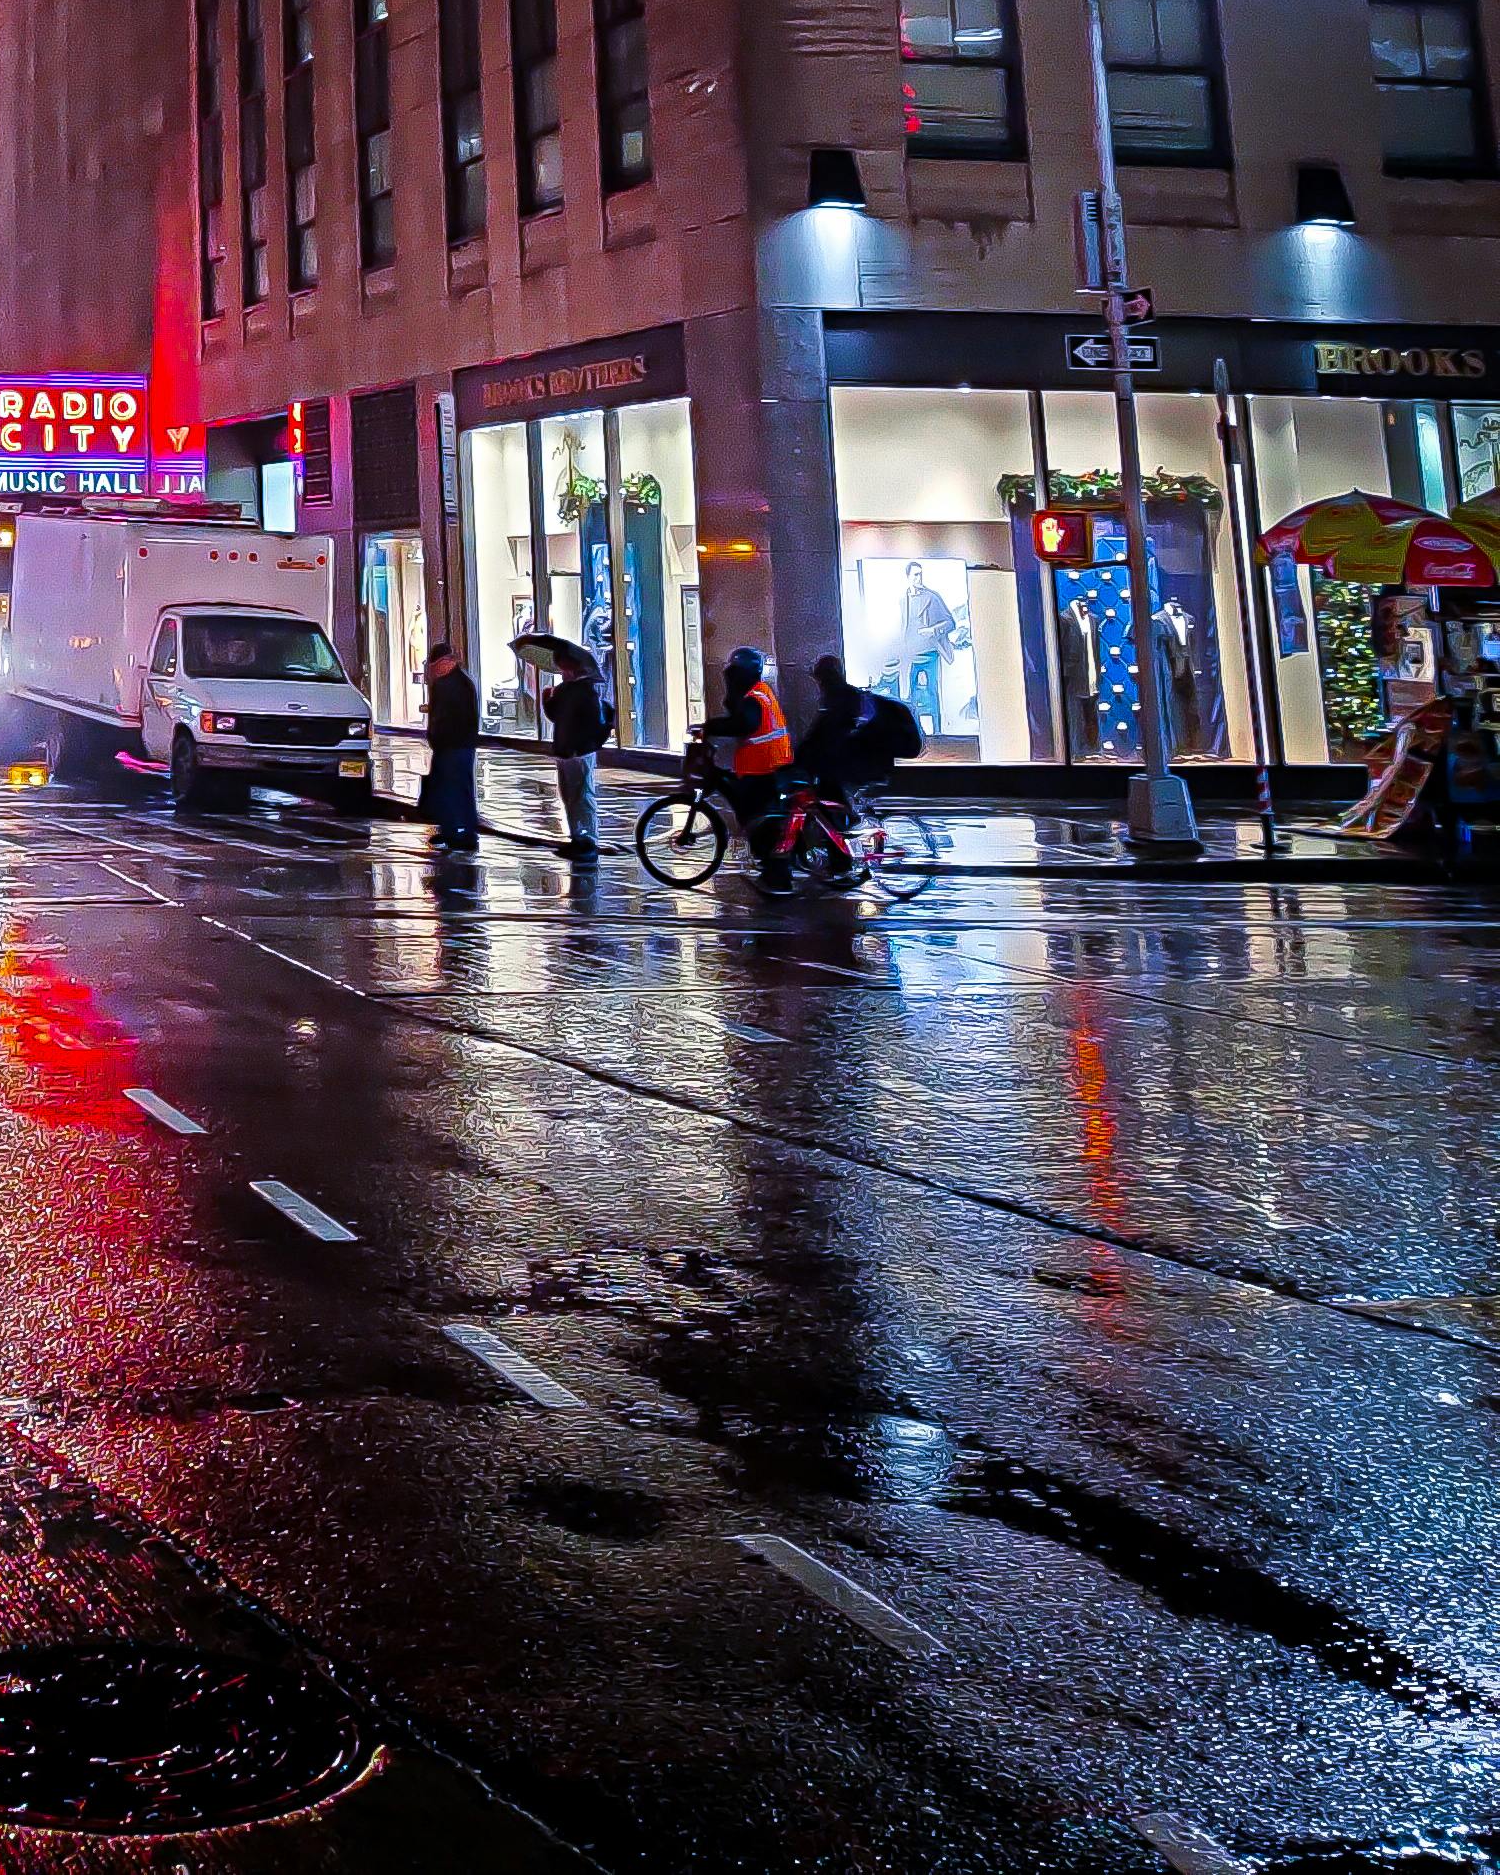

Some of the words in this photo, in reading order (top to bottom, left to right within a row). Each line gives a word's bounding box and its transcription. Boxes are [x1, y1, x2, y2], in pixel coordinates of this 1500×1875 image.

[1313, 345, 1486, 377] BROOKS
[0, 424, 136, 453] CITY
[78, 472, 144, 495] HALL
